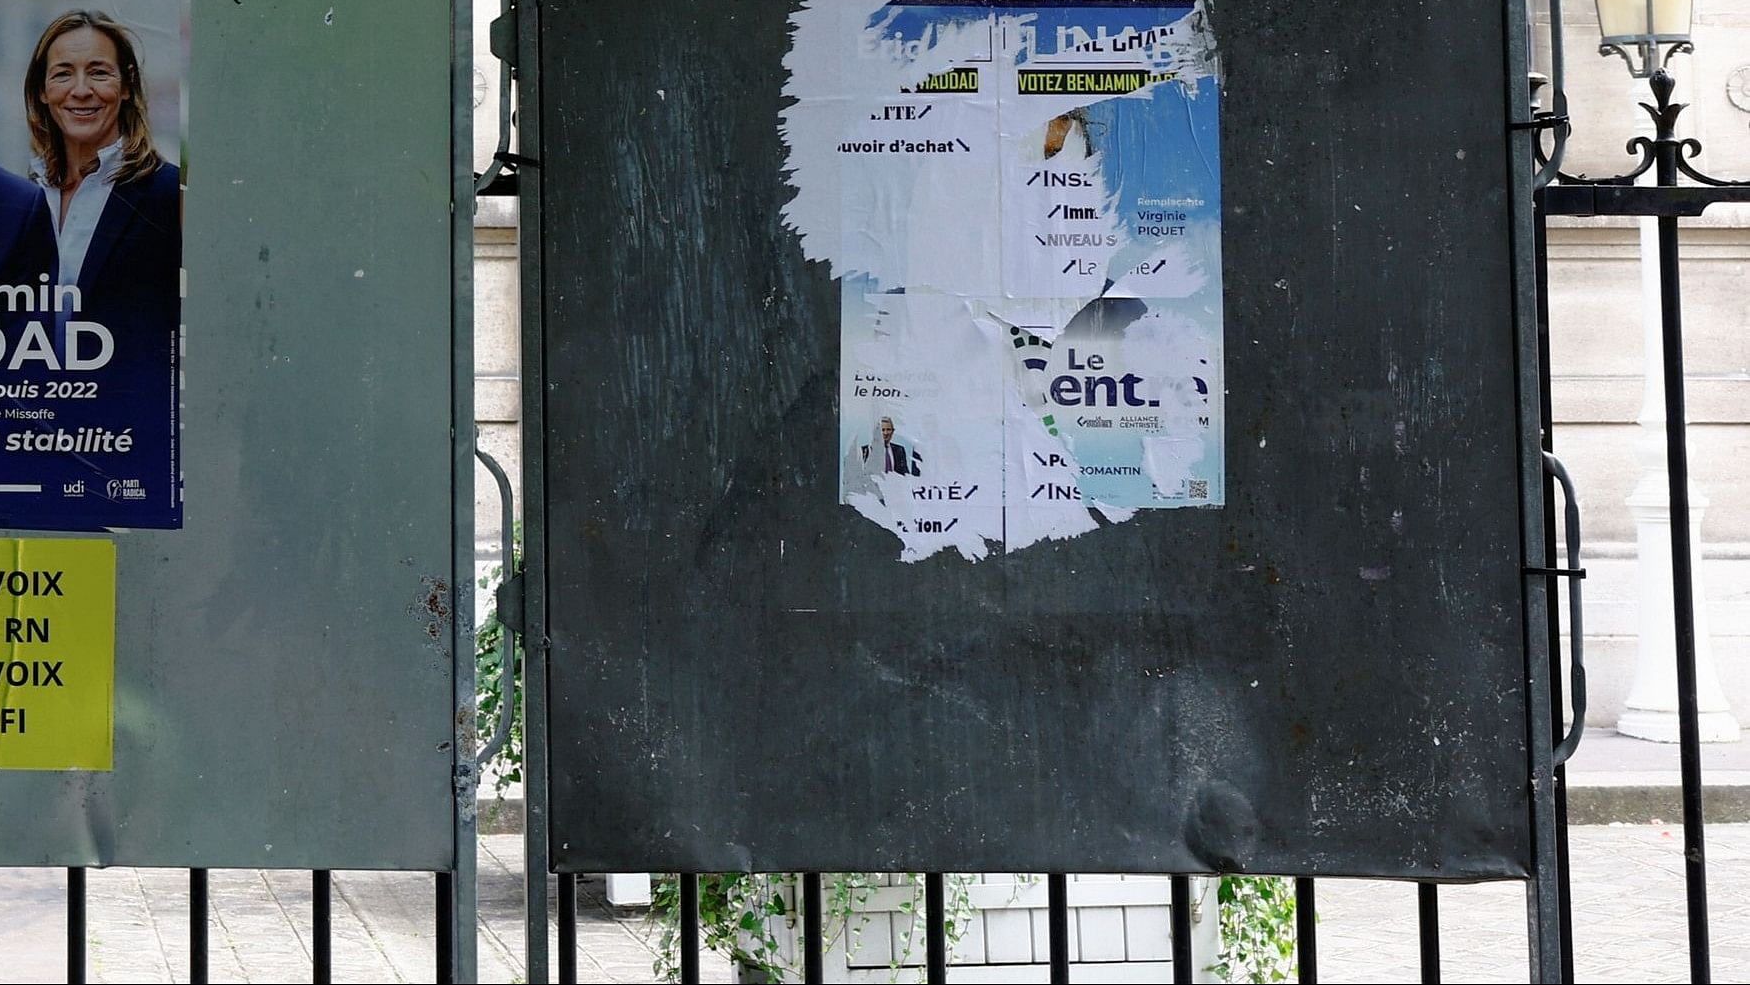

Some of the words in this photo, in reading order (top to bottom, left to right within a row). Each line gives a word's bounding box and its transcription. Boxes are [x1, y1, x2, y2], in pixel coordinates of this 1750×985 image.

[1019, 73, 1062, 91] VOTEZ
[1066, 72, 1140, 92] BENJAMIN
[1137, 211, 1187, 222] Virginie
[1138, 226, 1185, 237] PIQUET
[1047, 234, 1103, 247] NIVEAU
[1068, 348, 1105, 370] Le
[44, 382, 98, 399] 2022
[854, 385, 868, 397] le
[872, 385, 901, 398] bon
[5, 408, 55, 420] Missoffe
[5, 427, 133, 453] stabilité
[64, 480, 85, 494] udi
[123, 479, 140, 488] PARTI
[123, 488, 146, 497] RADICAL
[5, 617, 50, 643] RN
